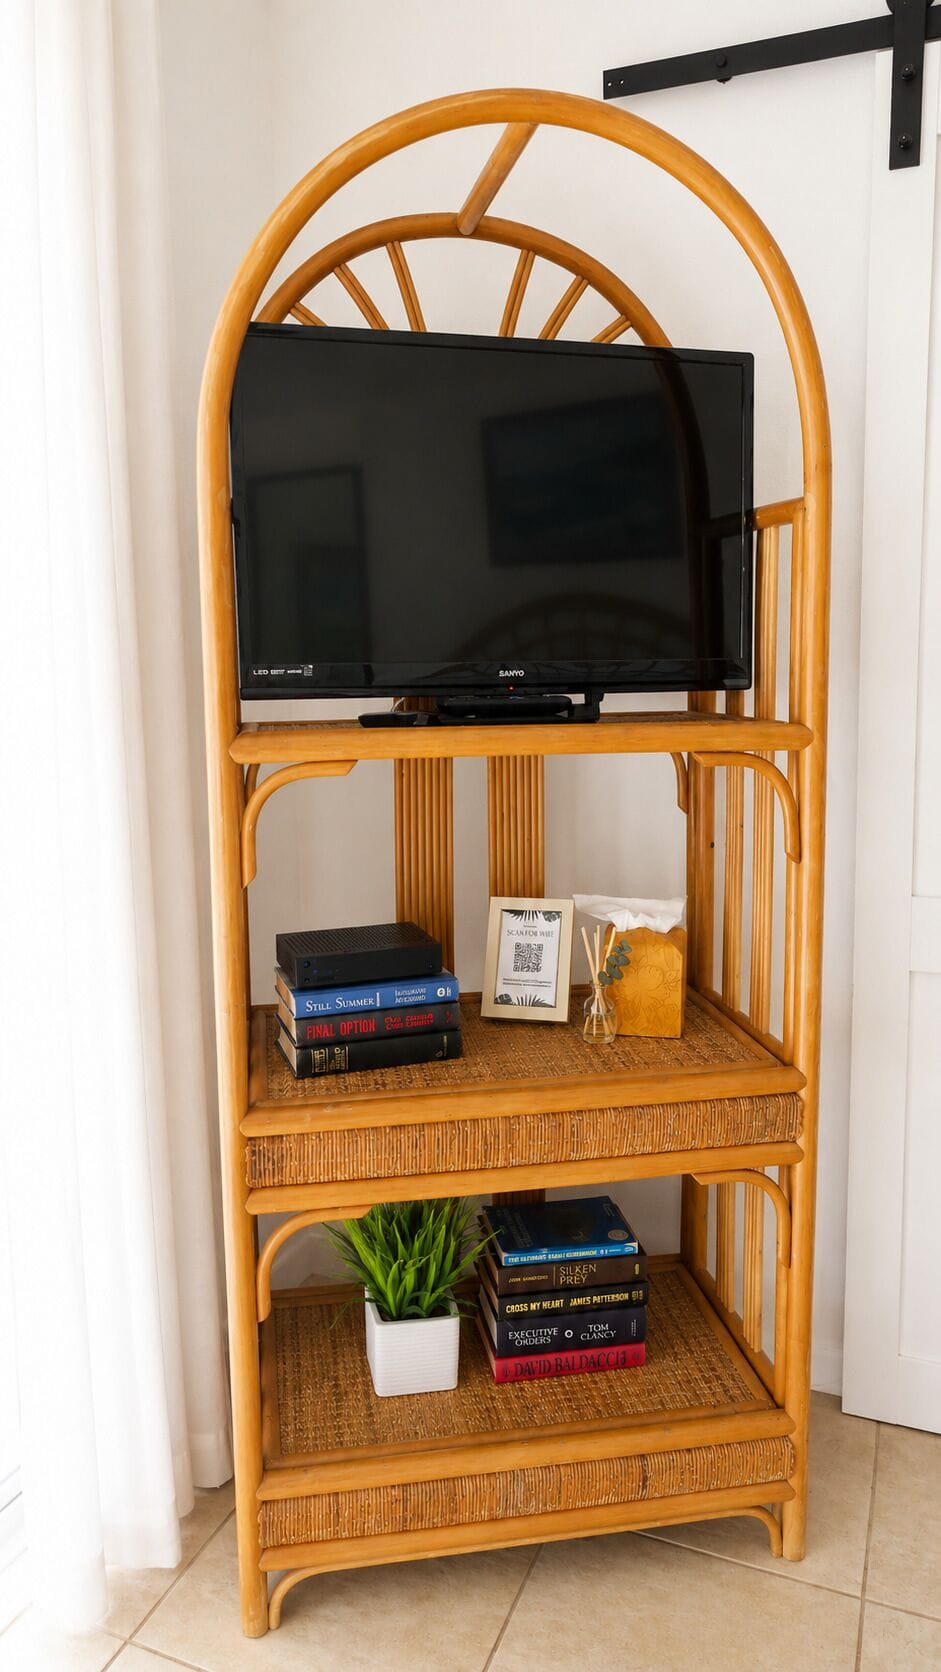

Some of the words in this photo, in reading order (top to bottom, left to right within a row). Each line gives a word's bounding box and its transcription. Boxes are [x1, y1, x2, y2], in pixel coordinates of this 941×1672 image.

[306, 1023, 336, 1040] FINAL
[340, 1018, 376, 1036] OPTION
[559, 1263, 597, 1277] SILKEN
[559, 1274, 588, 1286] PREY
[505, 1303, 529, 1313] CROSS
[530, 1302, 541, 1311] MY
[542, 1299, 564, 1309] HEART
[569, 1296, 591, 1307] JAMES
[592, 1292, 629, 1304] PATTERSON
[508, 1327, 559, 1340] EXECUTIVE
[588, 1323, 609, 1332] TOM
[515, 1335, 552, 1346] ORDERS
[580, 1330, 616, 1341] CLANCY
[514, 1360, 552, 1376] DAVID
